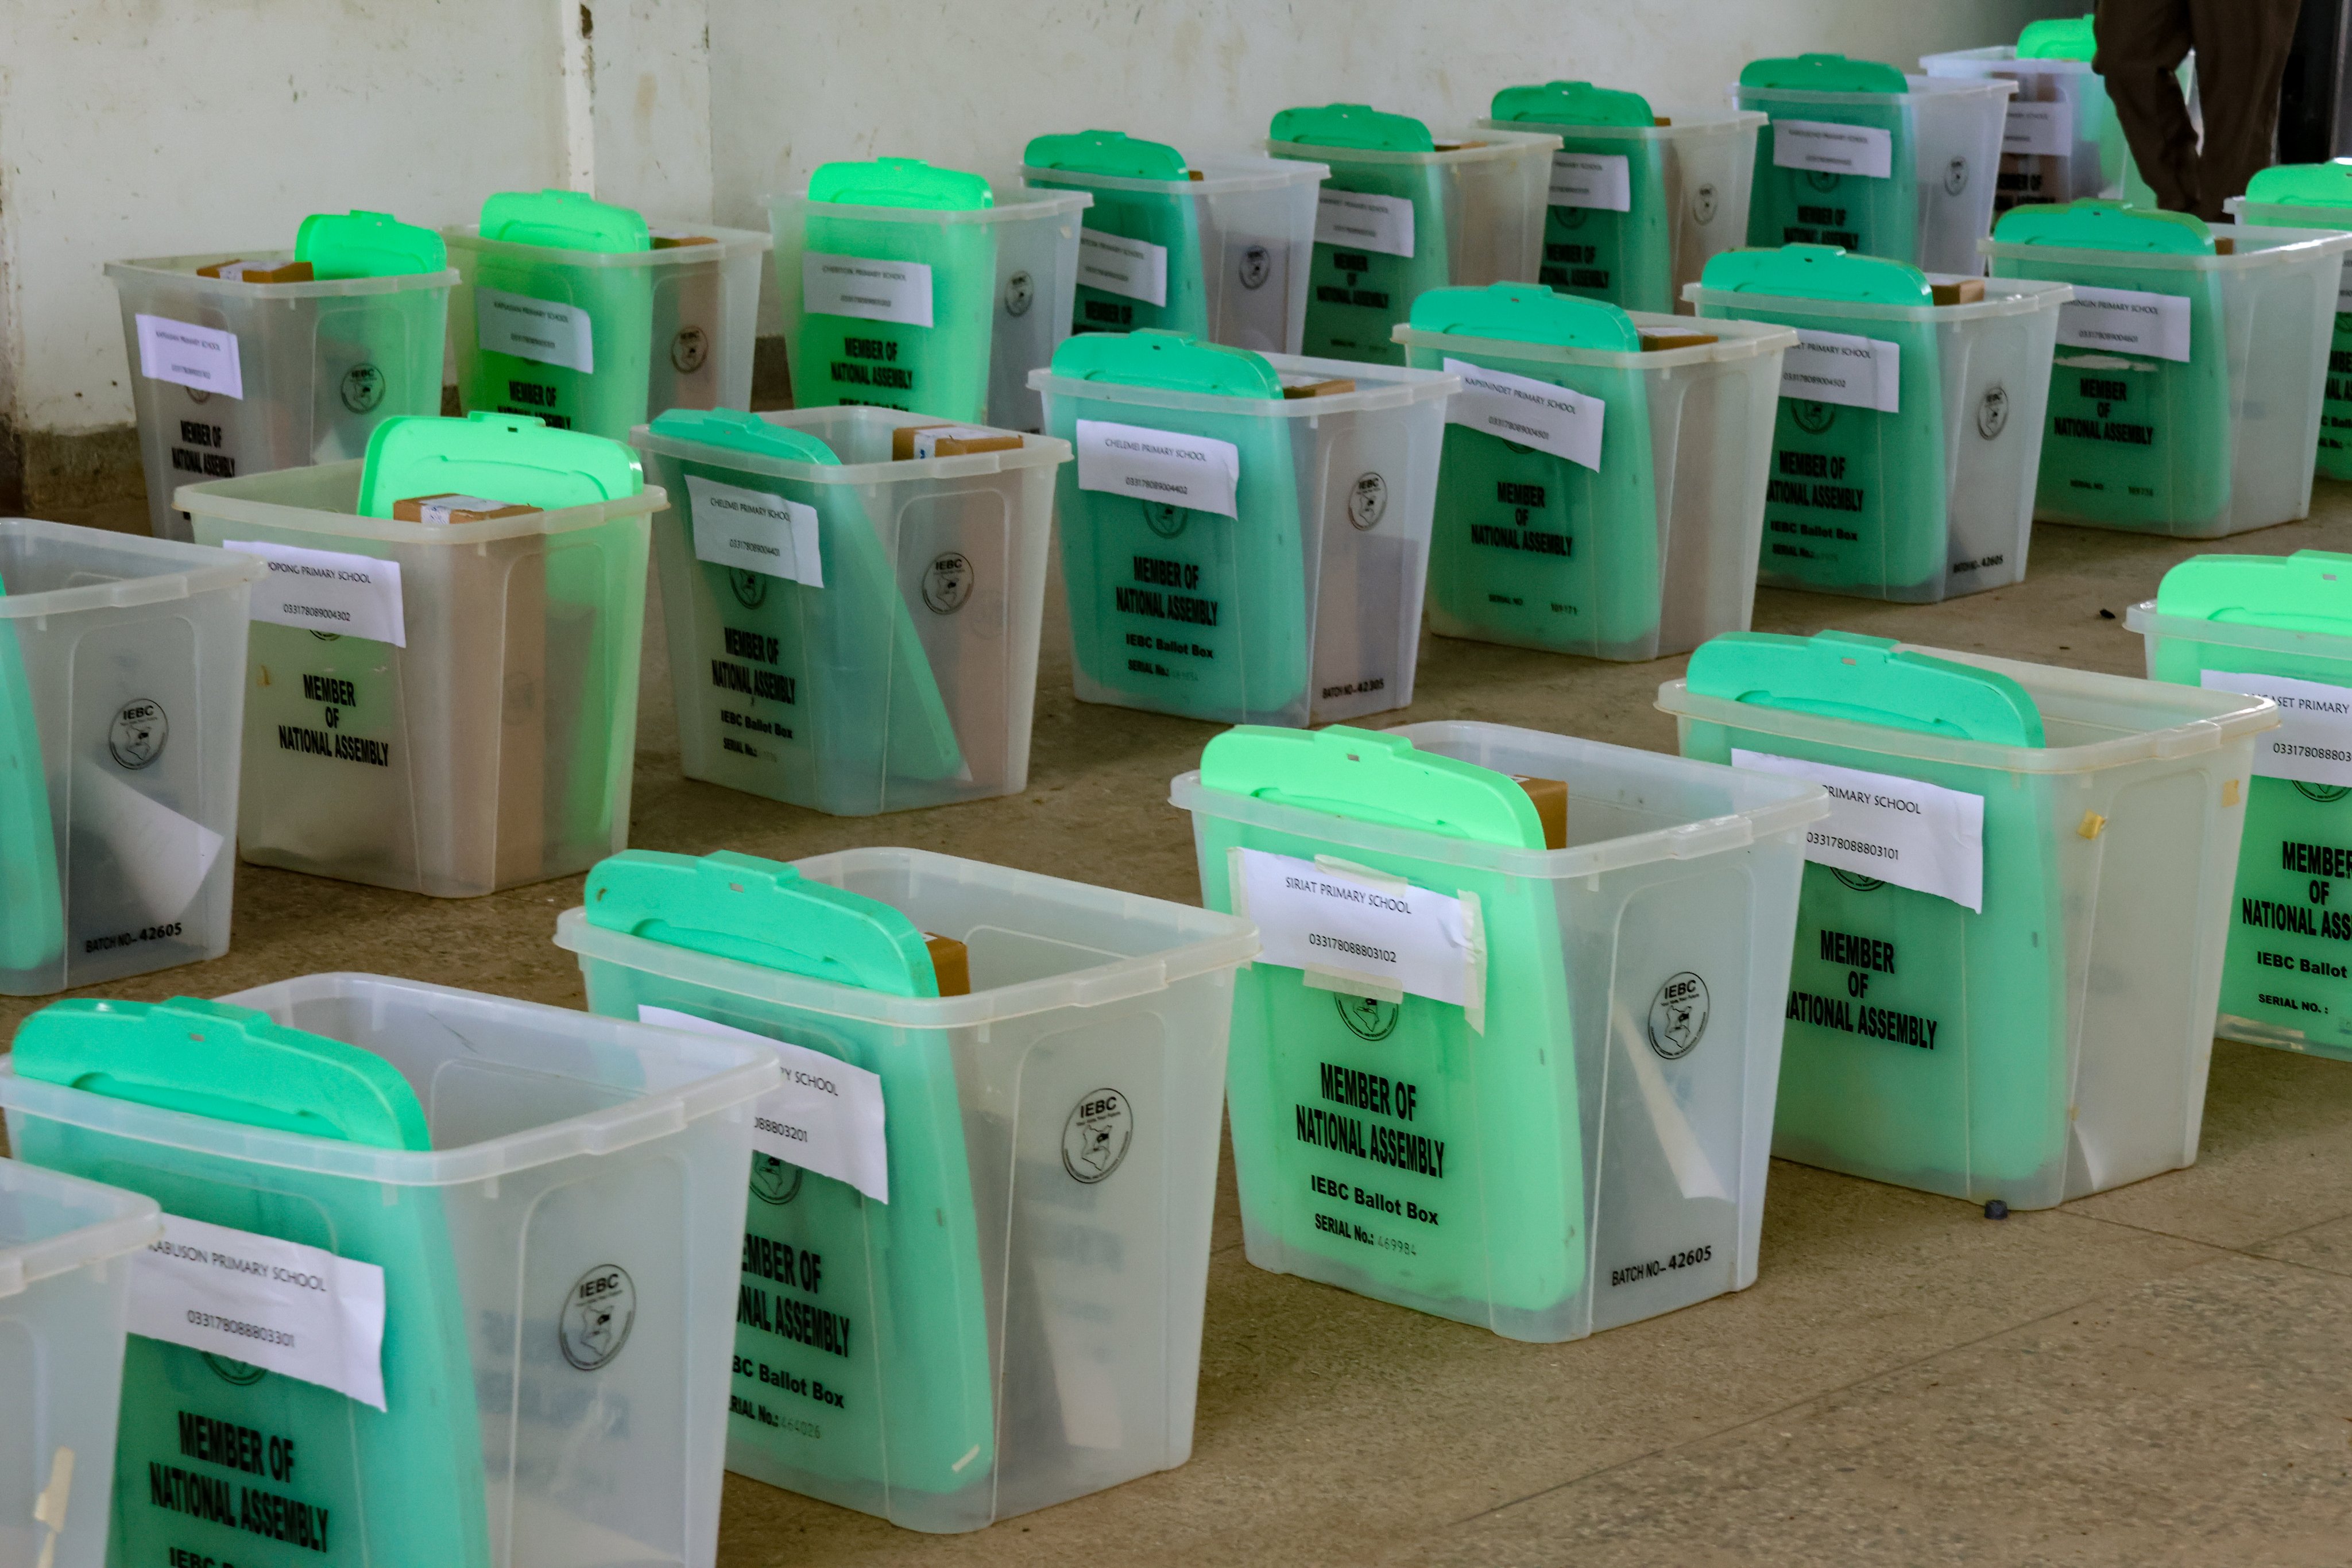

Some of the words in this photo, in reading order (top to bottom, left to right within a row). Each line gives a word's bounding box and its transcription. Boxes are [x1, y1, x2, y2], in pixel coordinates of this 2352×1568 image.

[845, 337, 885, 361] MEMBER
[885, 341, 898, 361] OF
[1842, 347, 1871, 359] SCHOOL
[830, 361, 871, 385] NATIONAL
[872, 366, 912, 390] ASSEMBLY
[2080, 378, 2127, 401] MEMBER
[508, 380, 544, 405] MEMBER
[545, 385, 556, 408] OF
[1513, 389, 1545, 405] PRIMARY
[1547, 398, 1576, 415] SCHOOL
[2096, 402, 2111, 419] OF
[180, 420, 211, 448] MEMBER
[212, 425, 222, 448] OF
[2054, 417, 2102, 440] NATIONAL
[2104, 423, 2154, 446] ASSEMBLY
[1142, 443, 1174, 455] PRIMARY
[1175, 449, 1207, 462] SCHOOL
[1780, 450, 1828, 479] MEMBER
[1830, 456, 1846, 480] OF
[1497, 481, 1546, 508] MEMBER
[1812, 486, 1864, 513] ASSEMBLY
[740, 504, 767, 517] PRIMARY
[768, 509, 791, 523] SCHOOL
[1515, 509, 1529, 526] OF
[1471, 524, 1520, 551] NATIONAL
[1522, 531, 1573, 557] ASSEMBLY
[1836, 528, 1858, 542] Box
[301, 566, 335, 579] PRIMARY
[338, 570, 372, 584] SCHOOL
[935, 557, 962, 571] IEBC
[1134, 555, 1182, 589] MEMBER
[1184, 563, 1200, 591] OF
[283, 603, 351, 622] 033178089004302
[1116, 586, 1166, 620] NATIONAL
[1167, 595, 1218, 627] ASSEMBLY
[724, 626, 765, 663] MEMBER
[766, 637, 779, 666] OF
[1125, 633, 1153, 649] IEBC
[1155, 637, 1189, 655] Ballot
[1191, 643, 1214, 659] Box
[303, 673, 357, 708] MEMBER
[711, 659, 753, 696] NATIONAL
[753, 668, 795, 706] ASSEMBLY
[122, 704, 155, 721] IEBC
[325, 707, 339, 729] OF
[2299, 698, 2350, 714] PRIMARY
[721, 710, 743, 727] IEBC
[744, 715, 772, 735] Ballot
[774, 722, 793, 740] Box
[278, 725, 332, 758] NATIONAL
[335, 734, 389, 768] ASSEMBLY
[2273, 743, 2352, 762] 033178088803
[1874, 795, 1921, 815] SCHOOL
[1806, 831, 1900, 861] 033178088803101
[1285, 876, 1318, 894] SIRIAT
[1320, 882, 1367, 904] PRIMARY
[1368, 893, 1413, 915] SCHOOL
[2309, 880, 2330, 906] OF
[2242, 897, 2317, 937] NATIONAL
[85, 937, 116, 954] BATCH
[138, 922, 183, 940] 42605
[1308, 932, 1398, 963] 033178088803102
[1820, 929, 1896, 974] MEMBER
[2257, 951, 2295, 970] IEBC
[2299, 958, 2348, 979] Ballot
[1664, 979, 1697, 1000] IEBC
[1847, 970, 1869, 1000] OF
[2258, 993, 2299, 1010] SERIAL
[1856, 1004, 1938, 1051] ASSEMBLY
[794, 1071, 839, 1097] SCHOOL
[1321, 1062, 1392, 1117] MEMBER
[1394, 1081, 1417, 1122] OF
[1080, 1096, 1117, 1118] IEBC
[1295, 1103, 1367, 1159] NATIONAL
[1370, 1124, 1445, 1179] ASSEMBLY
[1310, 1174, 1349, 1201] IEBC
[1353, 1186, 1402, 1217] Ballot
[1406, 1201, 1440, 1226] Box
[1314, 1213, 1352, 1239] SERIAL
[211, 1252, 269, 1277] PRIMARY
[272, 1265, 327, 1292] SCHOOL
[799, 1249, 822, 1295] OF
[1612, 1263, 1645, 1287] BATCH
[1668, 1244, 1713, 1272] 42605
[579, 1273, 619, 1299] IEBC
[187, 1309, 296, 1349] 033178088803301
[775, 1295, 850, 1358] ASSEMBLY
[759, 1362, 808, 1397] Ballot
[812, 1380, 845, 1410] Box
[178, 1410, 265, 1477] MEMBER
[268, 1434, 295, 1484] OF
[149, 1461, 237, 1528] NATIONAL
[240, 1485, 329, 1554] ASSEMBLY
